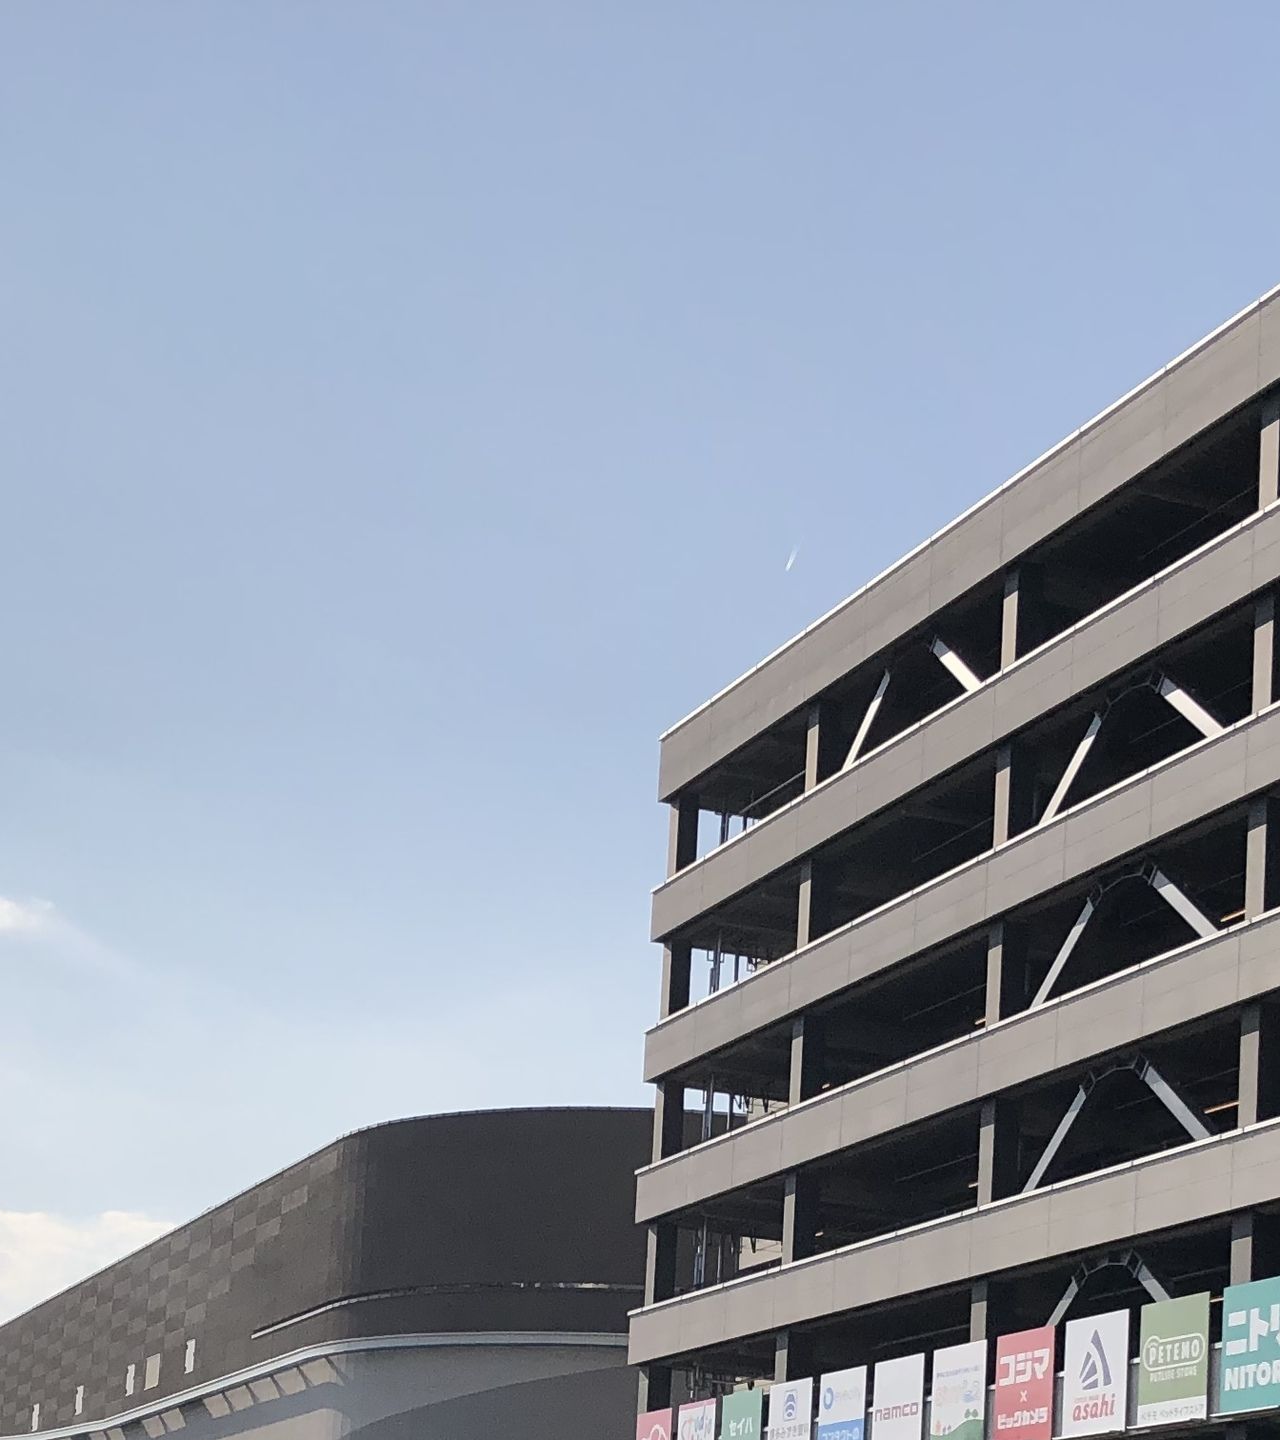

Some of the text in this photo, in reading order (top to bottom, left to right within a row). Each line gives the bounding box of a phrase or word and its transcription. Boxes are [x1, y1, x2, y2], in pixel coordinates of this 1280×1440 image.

[1149, 1339, 1200, 1366] PETEMO
[998, 1348, 1050, 1387] コジマ
[875, 1402, 919, 1422] namco
[997, 1407, 1048, 1430] ビックカメラ
[1072, 1393, 1115, 1421] asahi
[729, 1417, 753, 1437] セイハ
